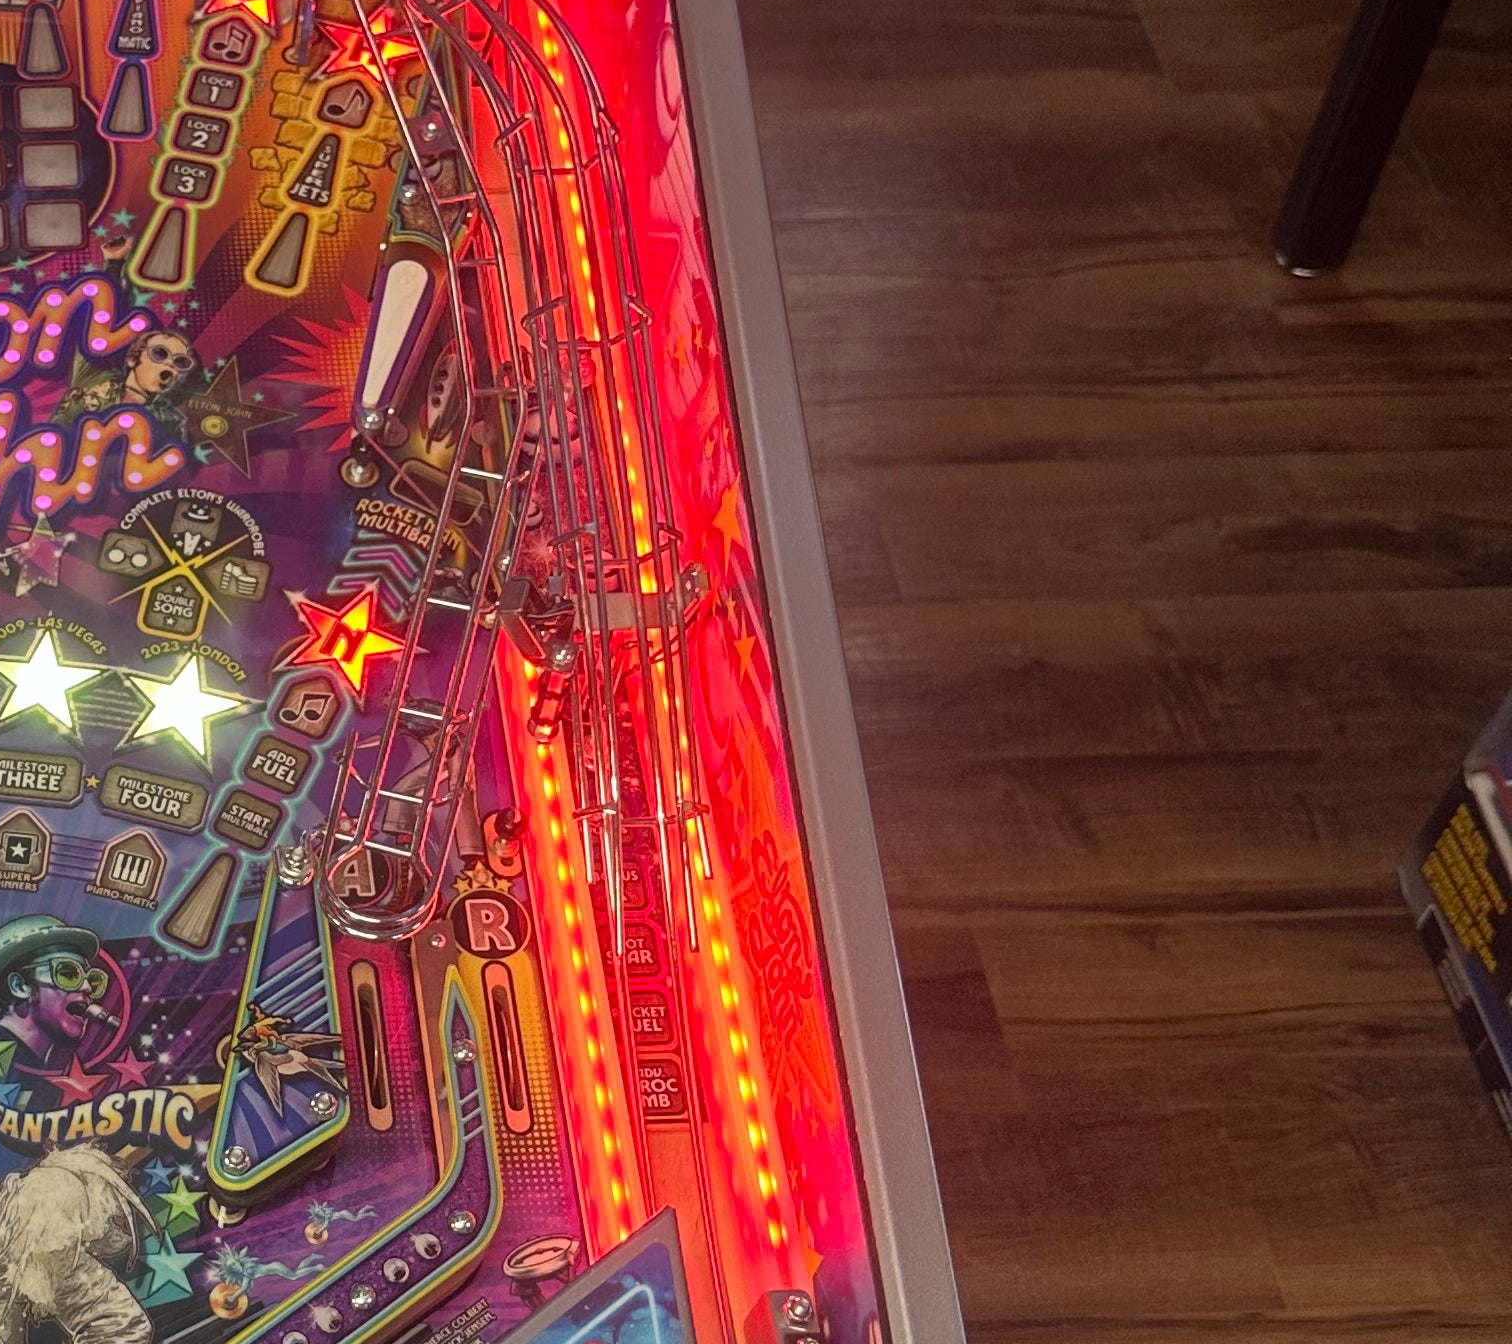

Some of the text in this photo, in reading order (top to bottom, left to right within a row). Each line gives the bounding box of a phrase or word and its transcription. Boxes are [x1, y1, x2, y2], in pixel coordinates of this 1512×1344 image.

[201, 75, 235, 89] LOCK
[208, 86, 218, 103] 1
[187, 118, 220, 133] LOCK
[191, 130, 209, 148] 2
[173, 163, 207, 178] LOCK
[176, 175, 195, 194] 3
[289, 182, 329, 204] JETS
[224, 406, 252, 420] JOHN
[120, 488, 266, 557] COMPLETE ELTON'S WARDROBE
[356, 498, 422, 524] ROCKET
[153, 602, 194, 619] SONG
[156, 592, 196, 607] DOUBLE
[37, 617, 64, 629] LAS
[67, 620, 108, 656] VEGAS
[328, 629, 364, 660] N
[141, 641, 248, 682] 2023 LONDON
[251, 755, 297, 786] FUEL
[267, 748, 296, 768] ADD
[118, 776, 192, 804] MILESTONE
[120, 788, 182, 818] FOUR
[220, 811, 270, 840] MULTIBALL
[228, 804, 271, 827] START
[334, 858, 375, 899] A
[86, 884, 158, 911] PIANO-MATIC
[465, 898, 513, 952] R
[451, 1298, 489, 1329] COLBERT
